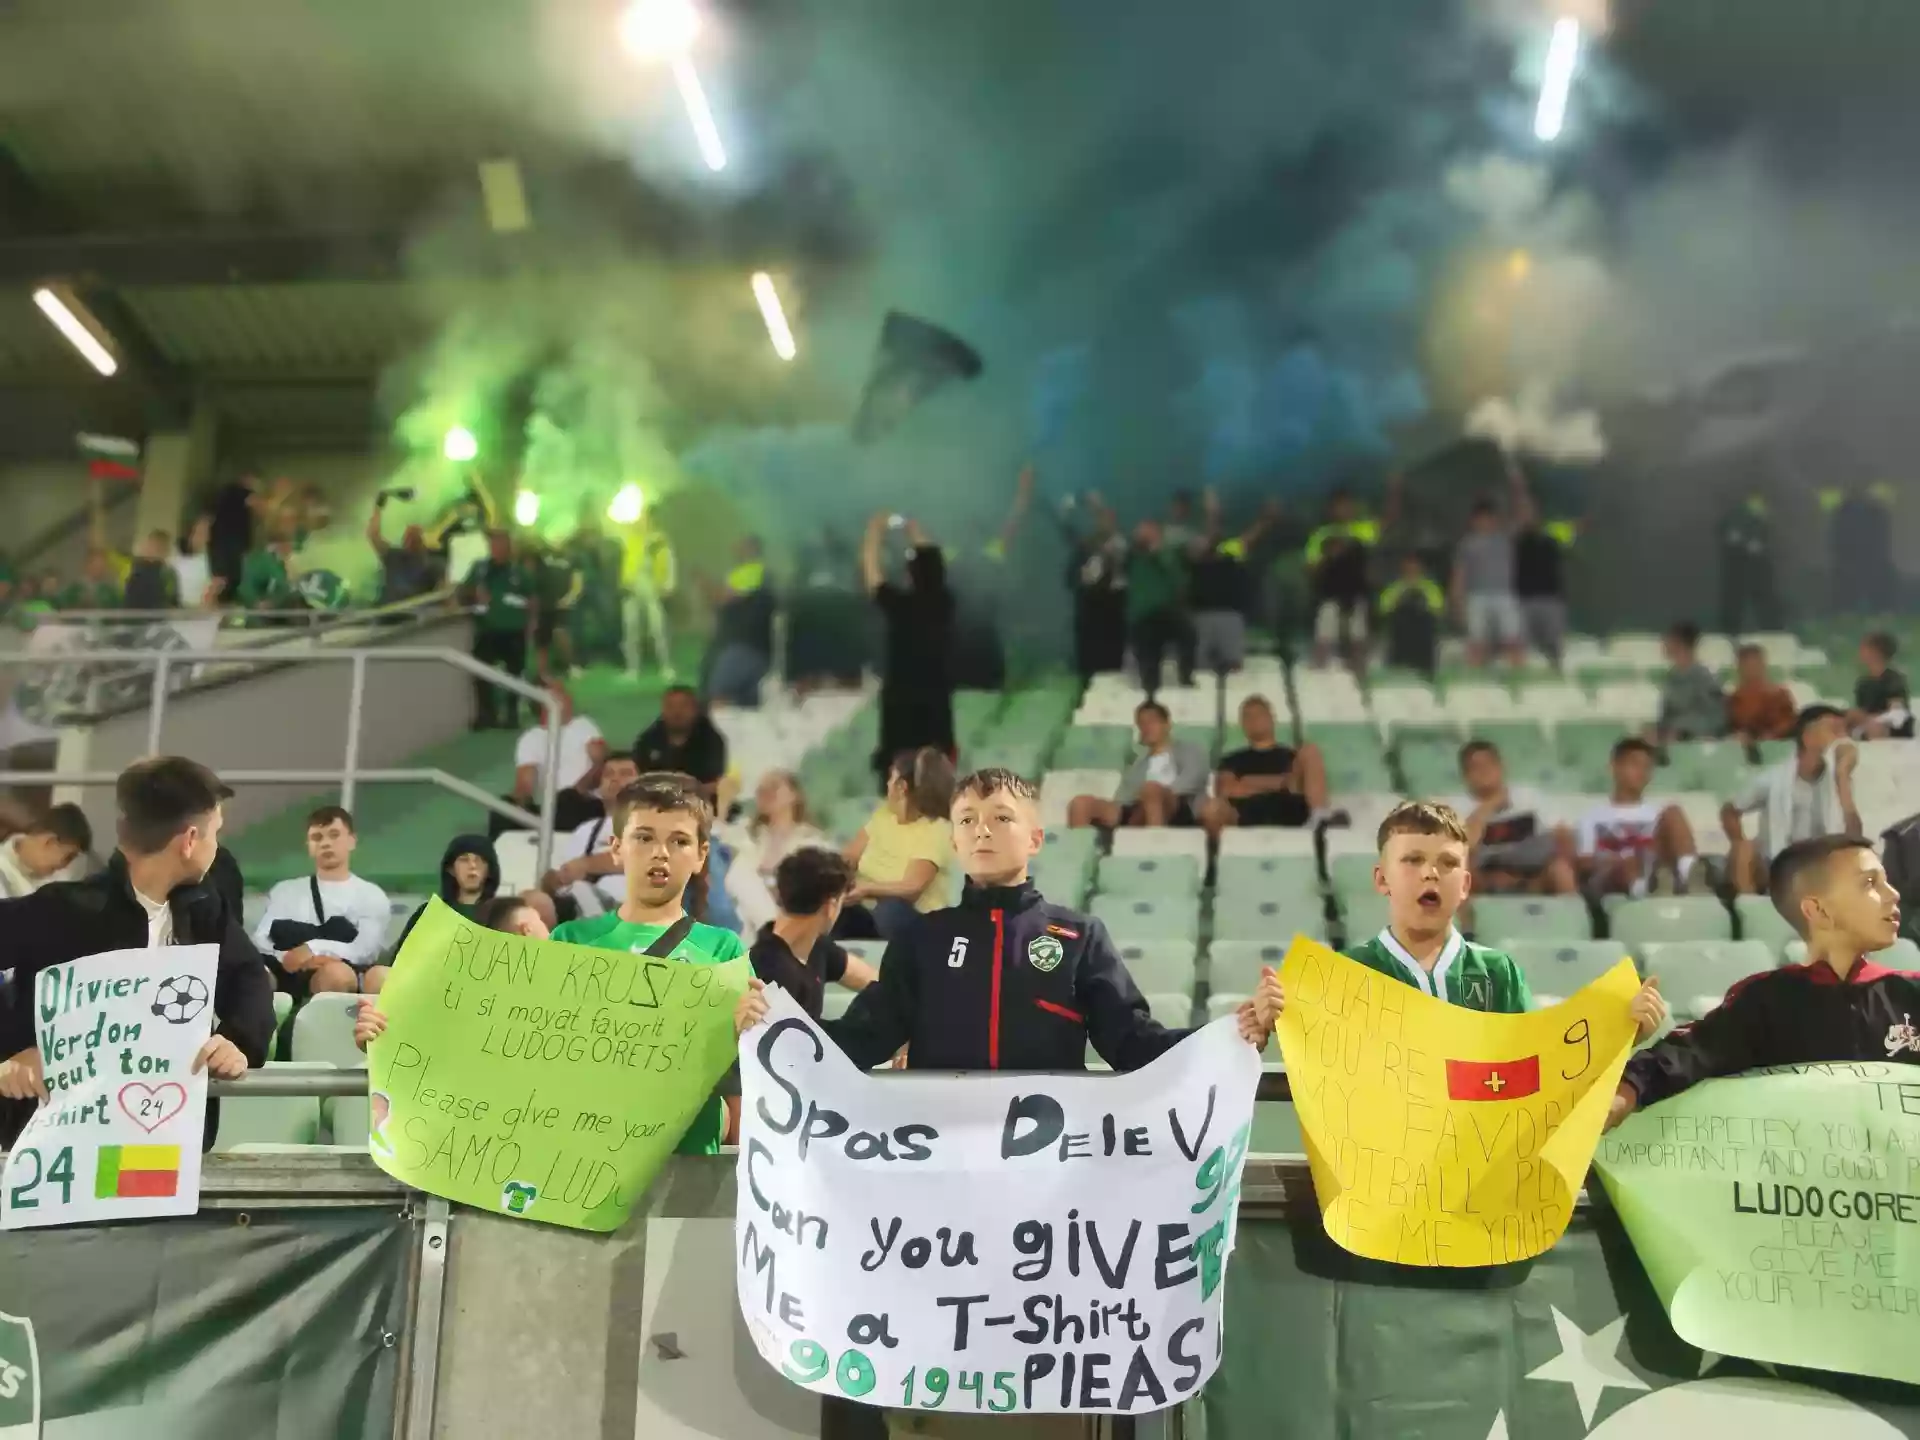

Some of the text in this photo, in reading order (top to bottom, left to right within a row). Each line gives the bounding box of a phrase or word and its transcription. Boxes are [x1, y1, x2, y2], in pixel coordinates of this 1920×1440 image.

[444, 923, 541, 985] RUAN
[947, 936, 970, 968] 5
[40, 966, 151, 1024] Olivier
[443, 981, 462, 1010] ti
[477, 994, 498, 1016] si
[507, 1004, 584, 1031] moyat
[590, 1007, 665, 1039] favorit
[1295, 954, 1406, 1040] DUAH
[41, 1011, 142, 1066] Verdon
[480, 1024, 693, 1073] LUDOGORETS!
[1562, 1018, 1591, 1080] 9
[43, 1047, 170, 1093] peut ton
[386, 1042, 490, 1121] Please
[572, 1111, 613, 1135] me
[607, 1120, 667, 1152] your
[755, 1017, 939, 1161] Spas
[140, 1098, 164, 1119] 24
[10, 1146, 76, 1209] 24
[403, 1116, 521, 1185] SAMO
[1602, 1138, 1747, 1172] IMPORTANT
[1759, 1149, 1807, 1177] AND
[747, 1137, 828, 1250] Can
[860, 1216, 978, 1272] you
[1750, 1245, 1900, 1280] GIVE ME
[1780, 1219, 1888, 1249] PLEASE
[742, 1221, 1151, 1352] ME a T-Shirt
[1716, 1267, 1796, 1304] YOUR
[781, 1338, 1018, 1413] 90 1945
